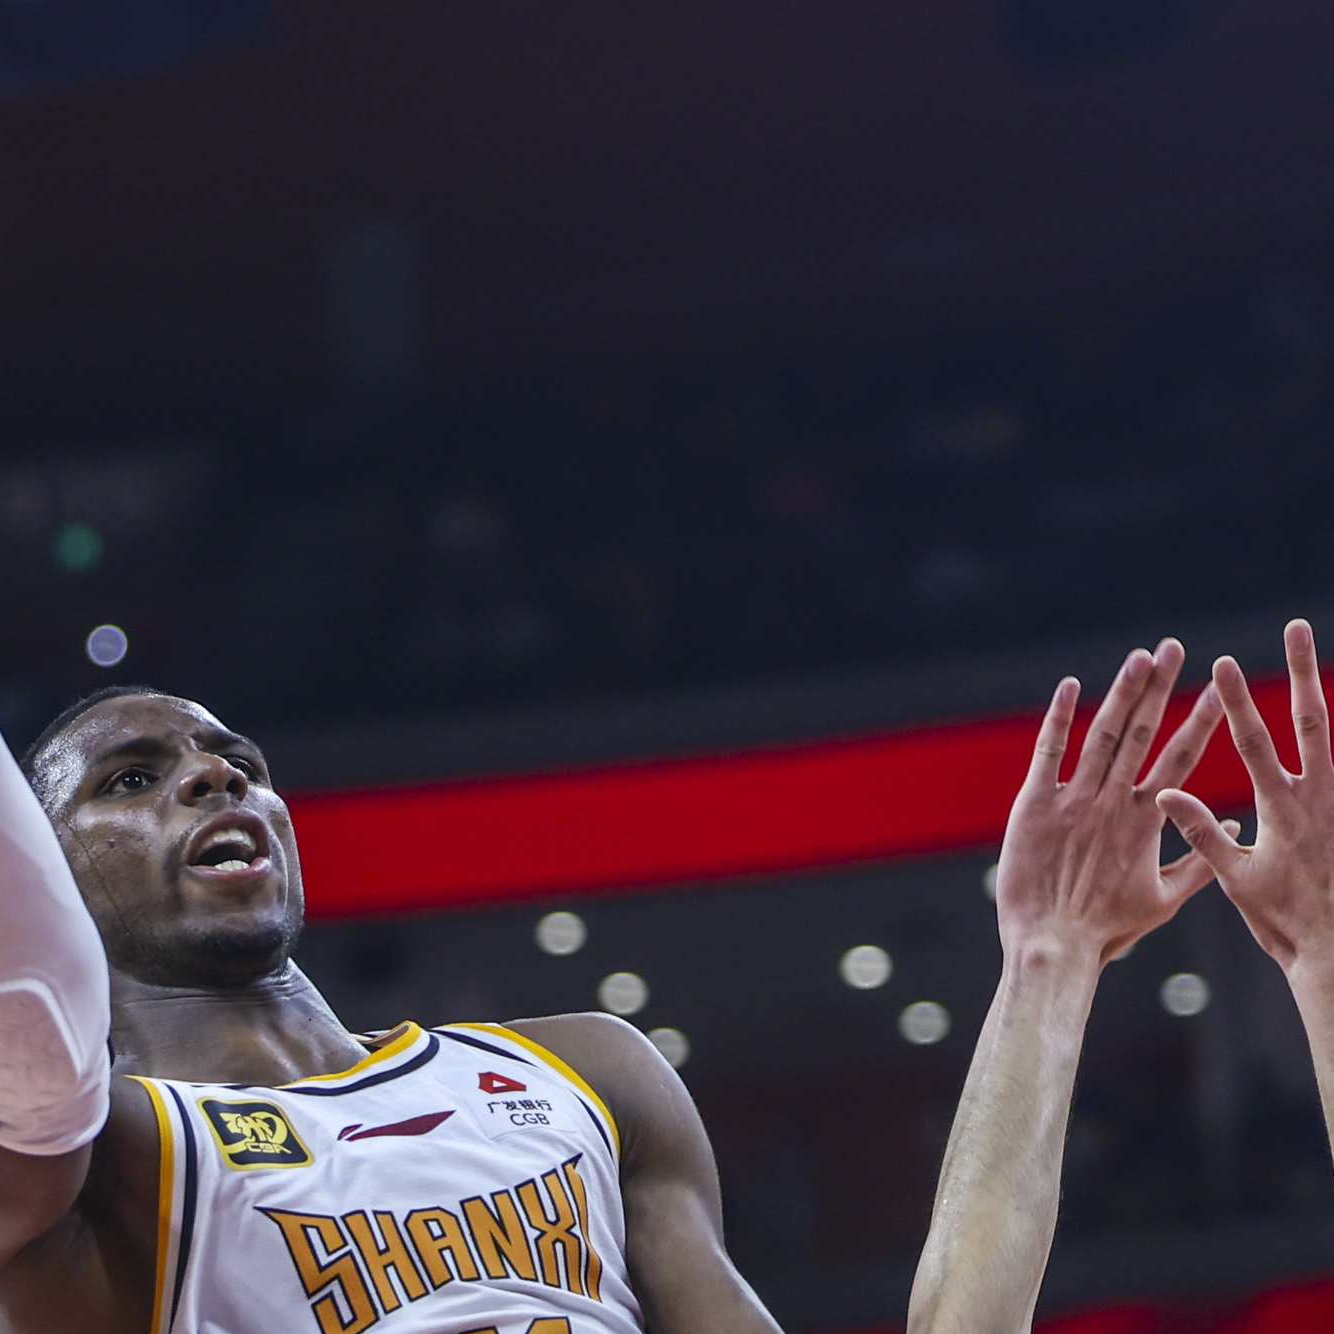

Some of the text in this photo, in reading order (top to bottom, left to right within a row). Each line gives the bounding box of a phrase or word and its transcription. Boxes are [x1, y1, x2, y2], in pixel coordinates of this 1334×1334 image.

[487, 1099, 553, 1114] 广发银行
[509, 1113, 551, 1126] CGB
